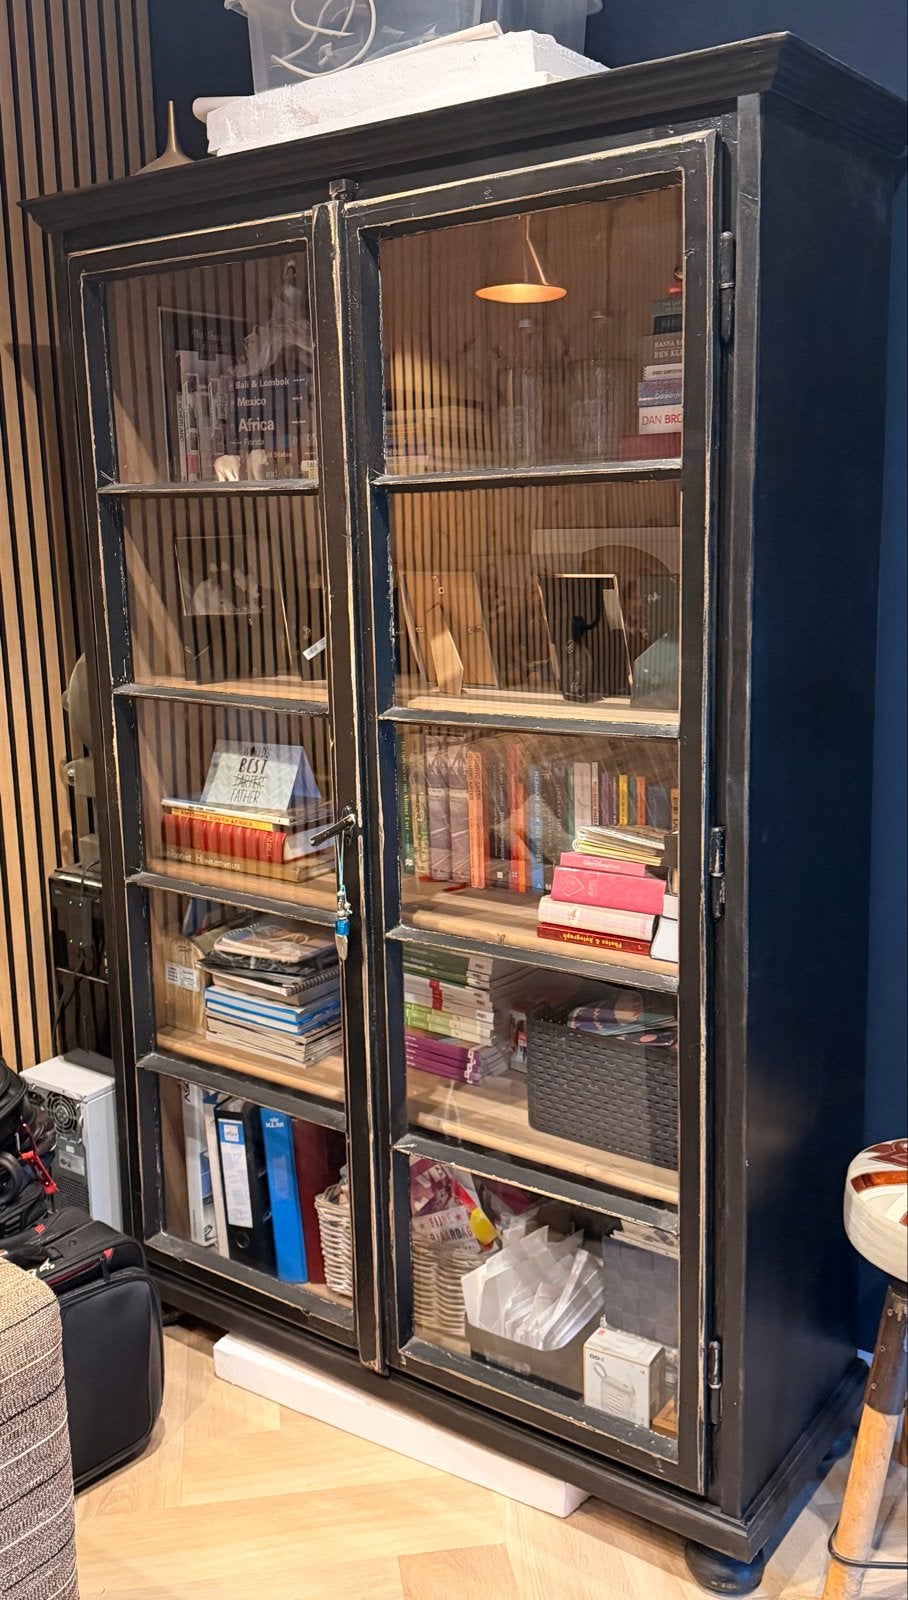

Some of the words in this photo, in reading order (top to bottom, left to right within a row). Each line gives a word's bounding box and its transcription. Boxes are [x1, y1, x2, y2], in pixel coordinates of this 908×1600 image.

[251, 380, 258, 388] &
[259, 377, 290, 387] Lombok
[237, 397, 267, 407] Mexico
[238, 418, 275, 432] Africa
[641, 414, 662, 426] DAN
[238, 757, 268, 773] BEST
[230, 788, 261, 804] FATHER
[265, 1121, 285, 1129] KLM
